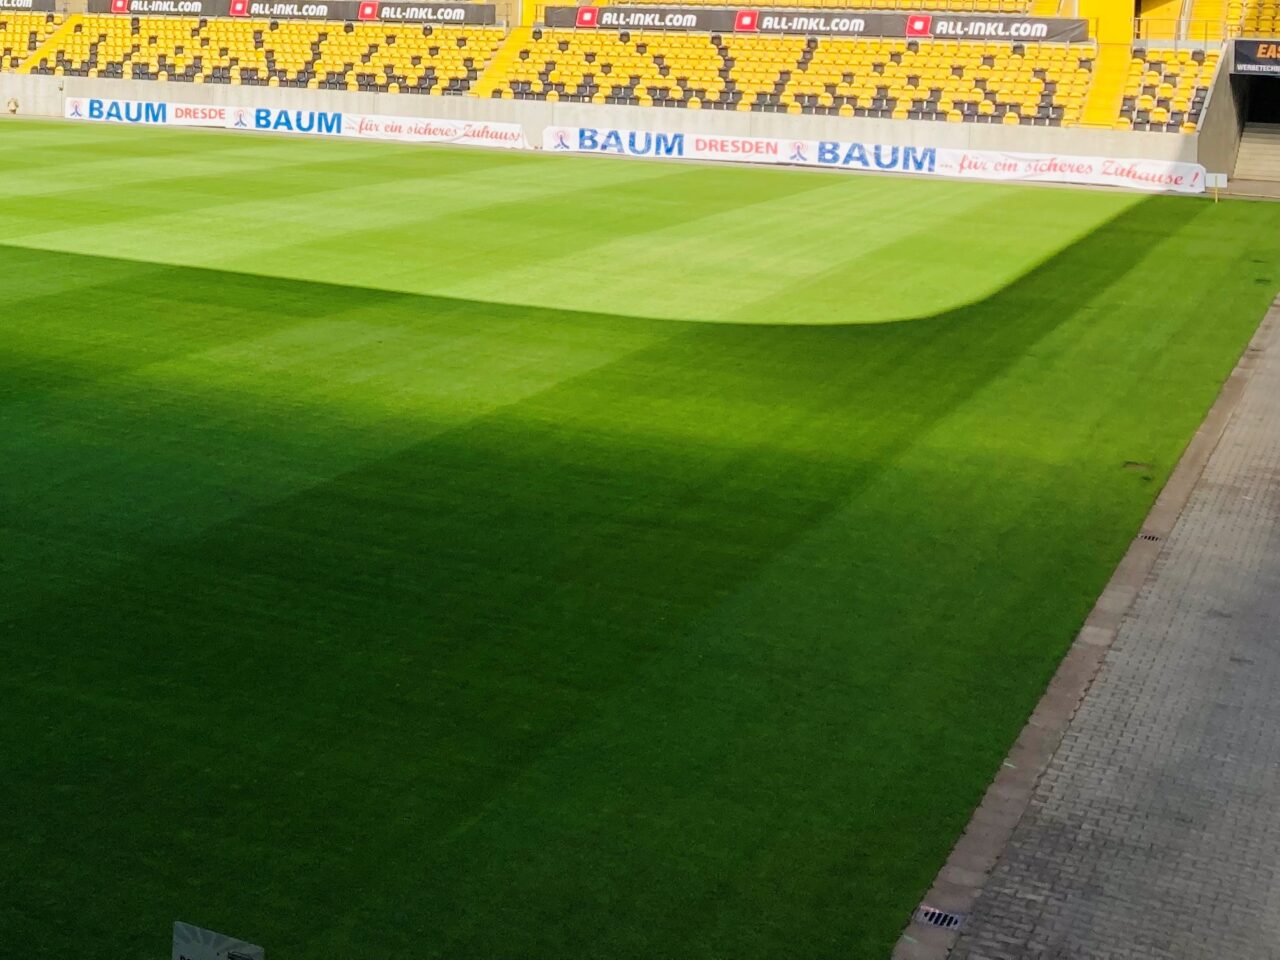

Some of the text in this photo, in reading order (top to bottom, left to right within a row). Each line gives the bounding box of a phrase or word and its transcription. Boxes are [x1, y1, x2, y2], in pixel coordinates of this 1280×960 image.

[88, 99, 167, 123] BAUM
[254, 108, 343, 134] BAUM
[357, 118, 380, 135] für
[384, 123, 402, 134] ein
[406, 122, 458, 137] sicheres
[578, 128, 684, 156] BAUM
[694, 138, 778, 155] DRESDEN
[817, 141, 936, 172] BAUM
[958, 153, 988, 175] für
[993, 159, 1018, 172] ein
[1024, 156, 1094, 175] sicheres
